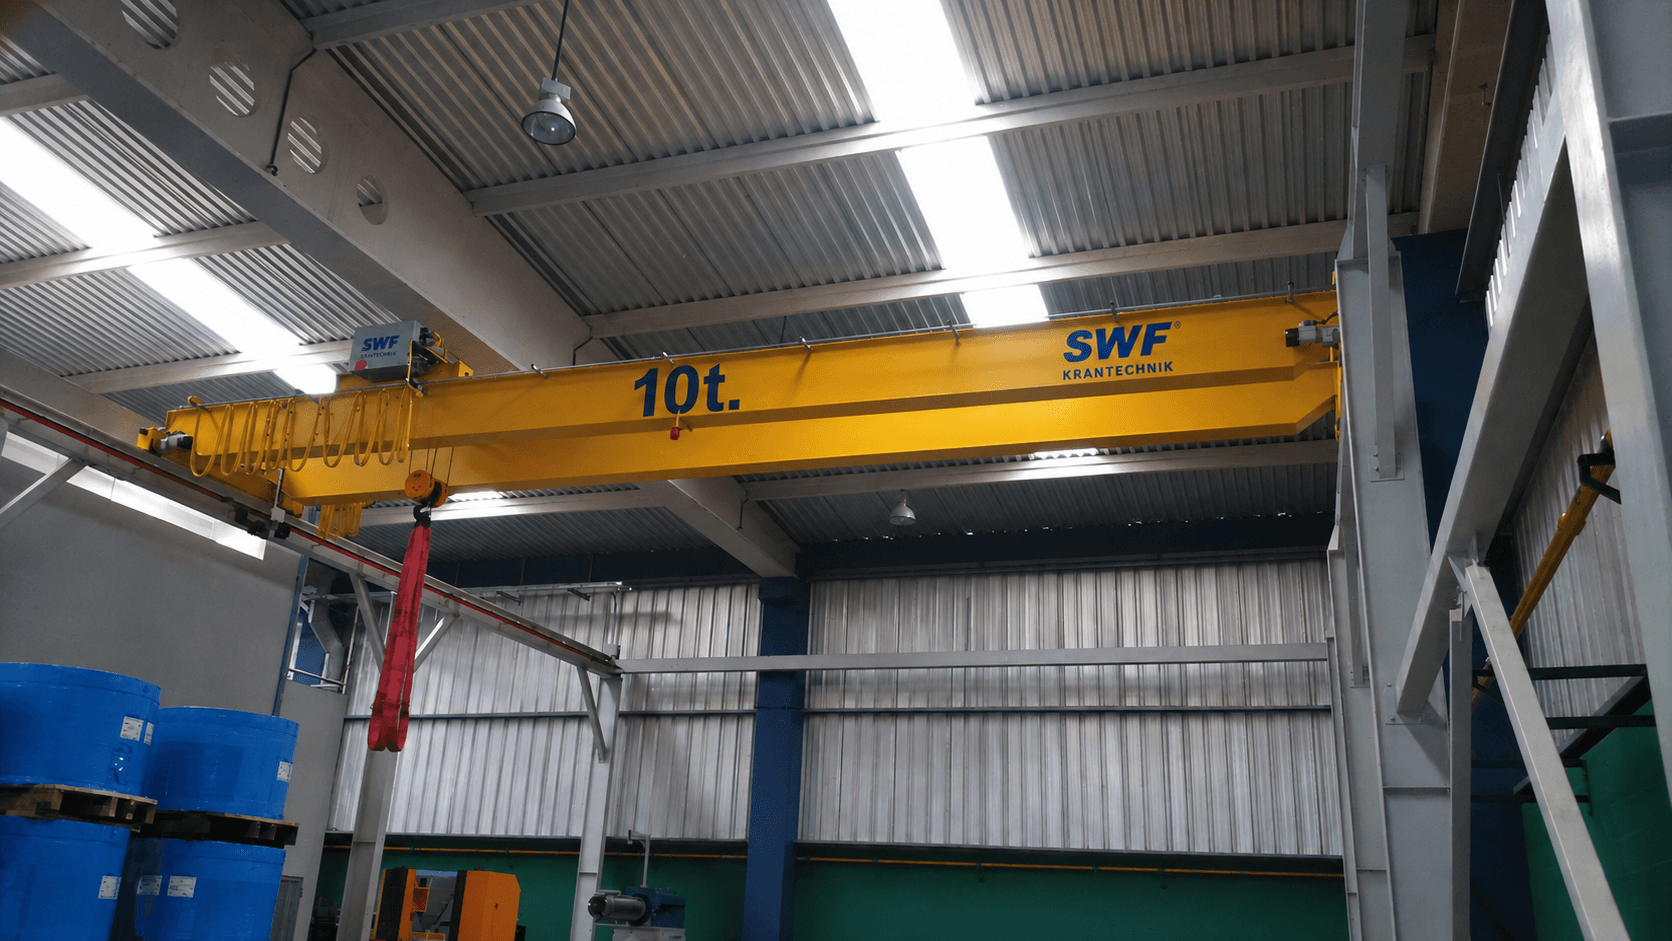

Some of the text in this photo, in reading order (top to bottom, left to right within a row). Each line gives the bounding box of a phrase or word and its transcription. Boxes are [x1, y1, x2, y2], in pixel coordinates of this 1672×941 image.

[361, 334, 400, 351] SWF
[1062, 361, 1174, 381] KRANTECHNIK
[634, 363, 740, 418] 10t.
